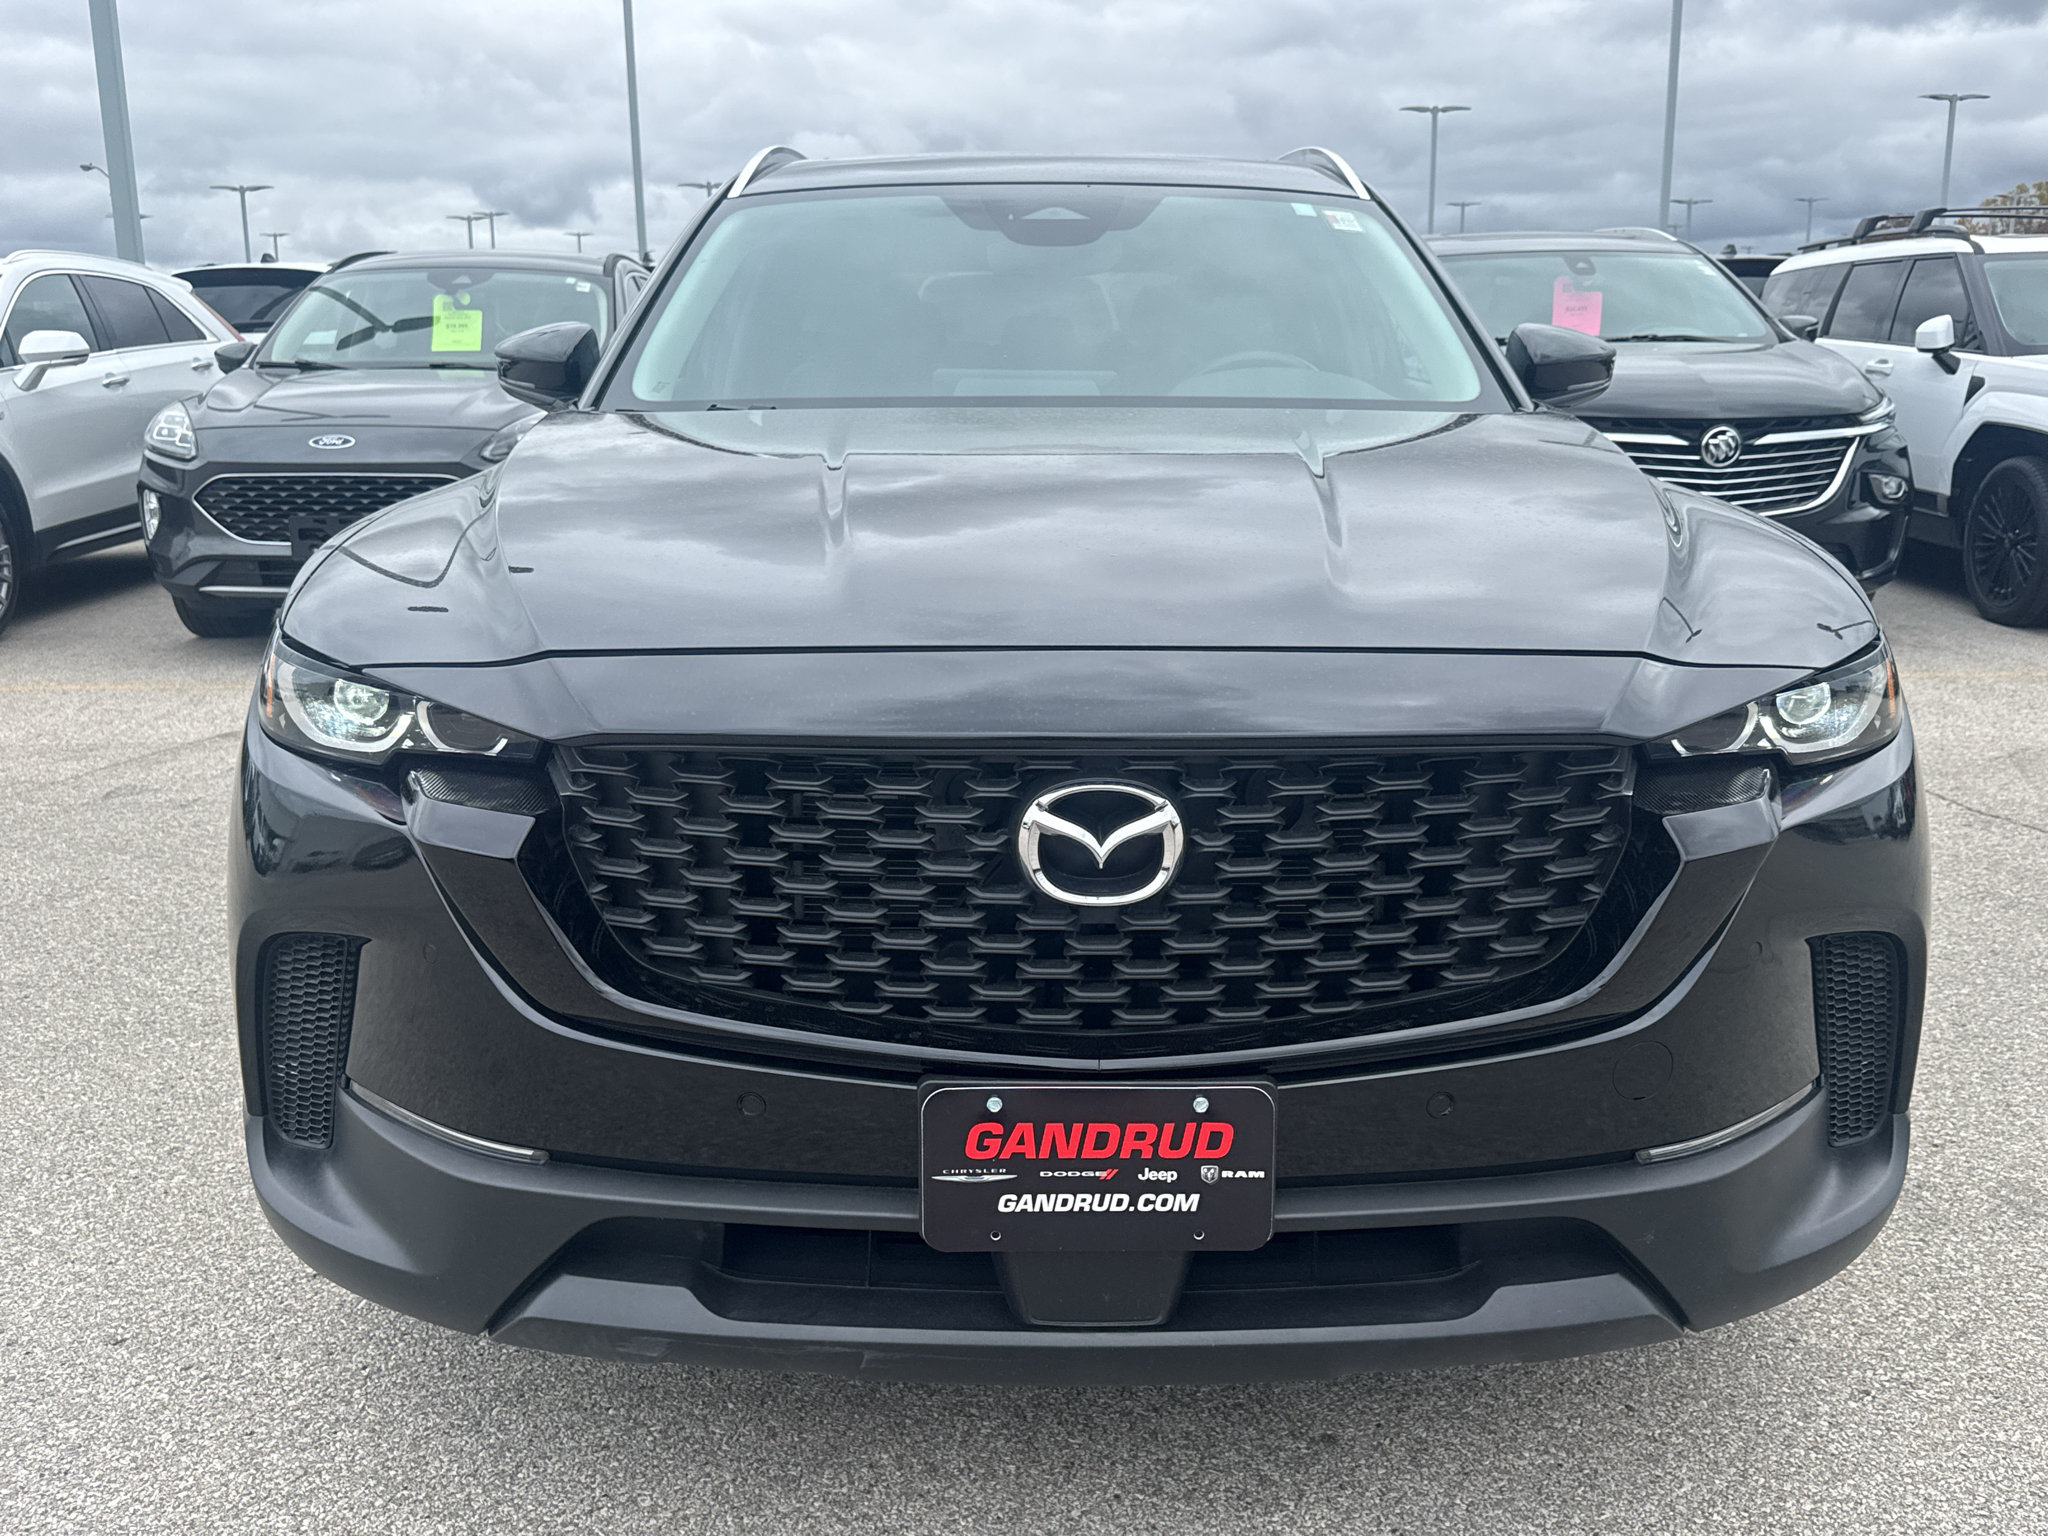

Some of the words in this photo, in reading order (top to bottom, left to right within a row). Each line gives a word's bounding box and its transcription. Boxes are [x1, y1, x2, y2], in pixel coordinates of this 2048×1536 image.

[965, 1122, 1234, 1159] GANDRUD
[1138, 1167, 1178, 1183] Jeep
[1222, 1170, 1265, 1178] RAM
[998, 1193, 1200, 1213] GANDRUD.COM
